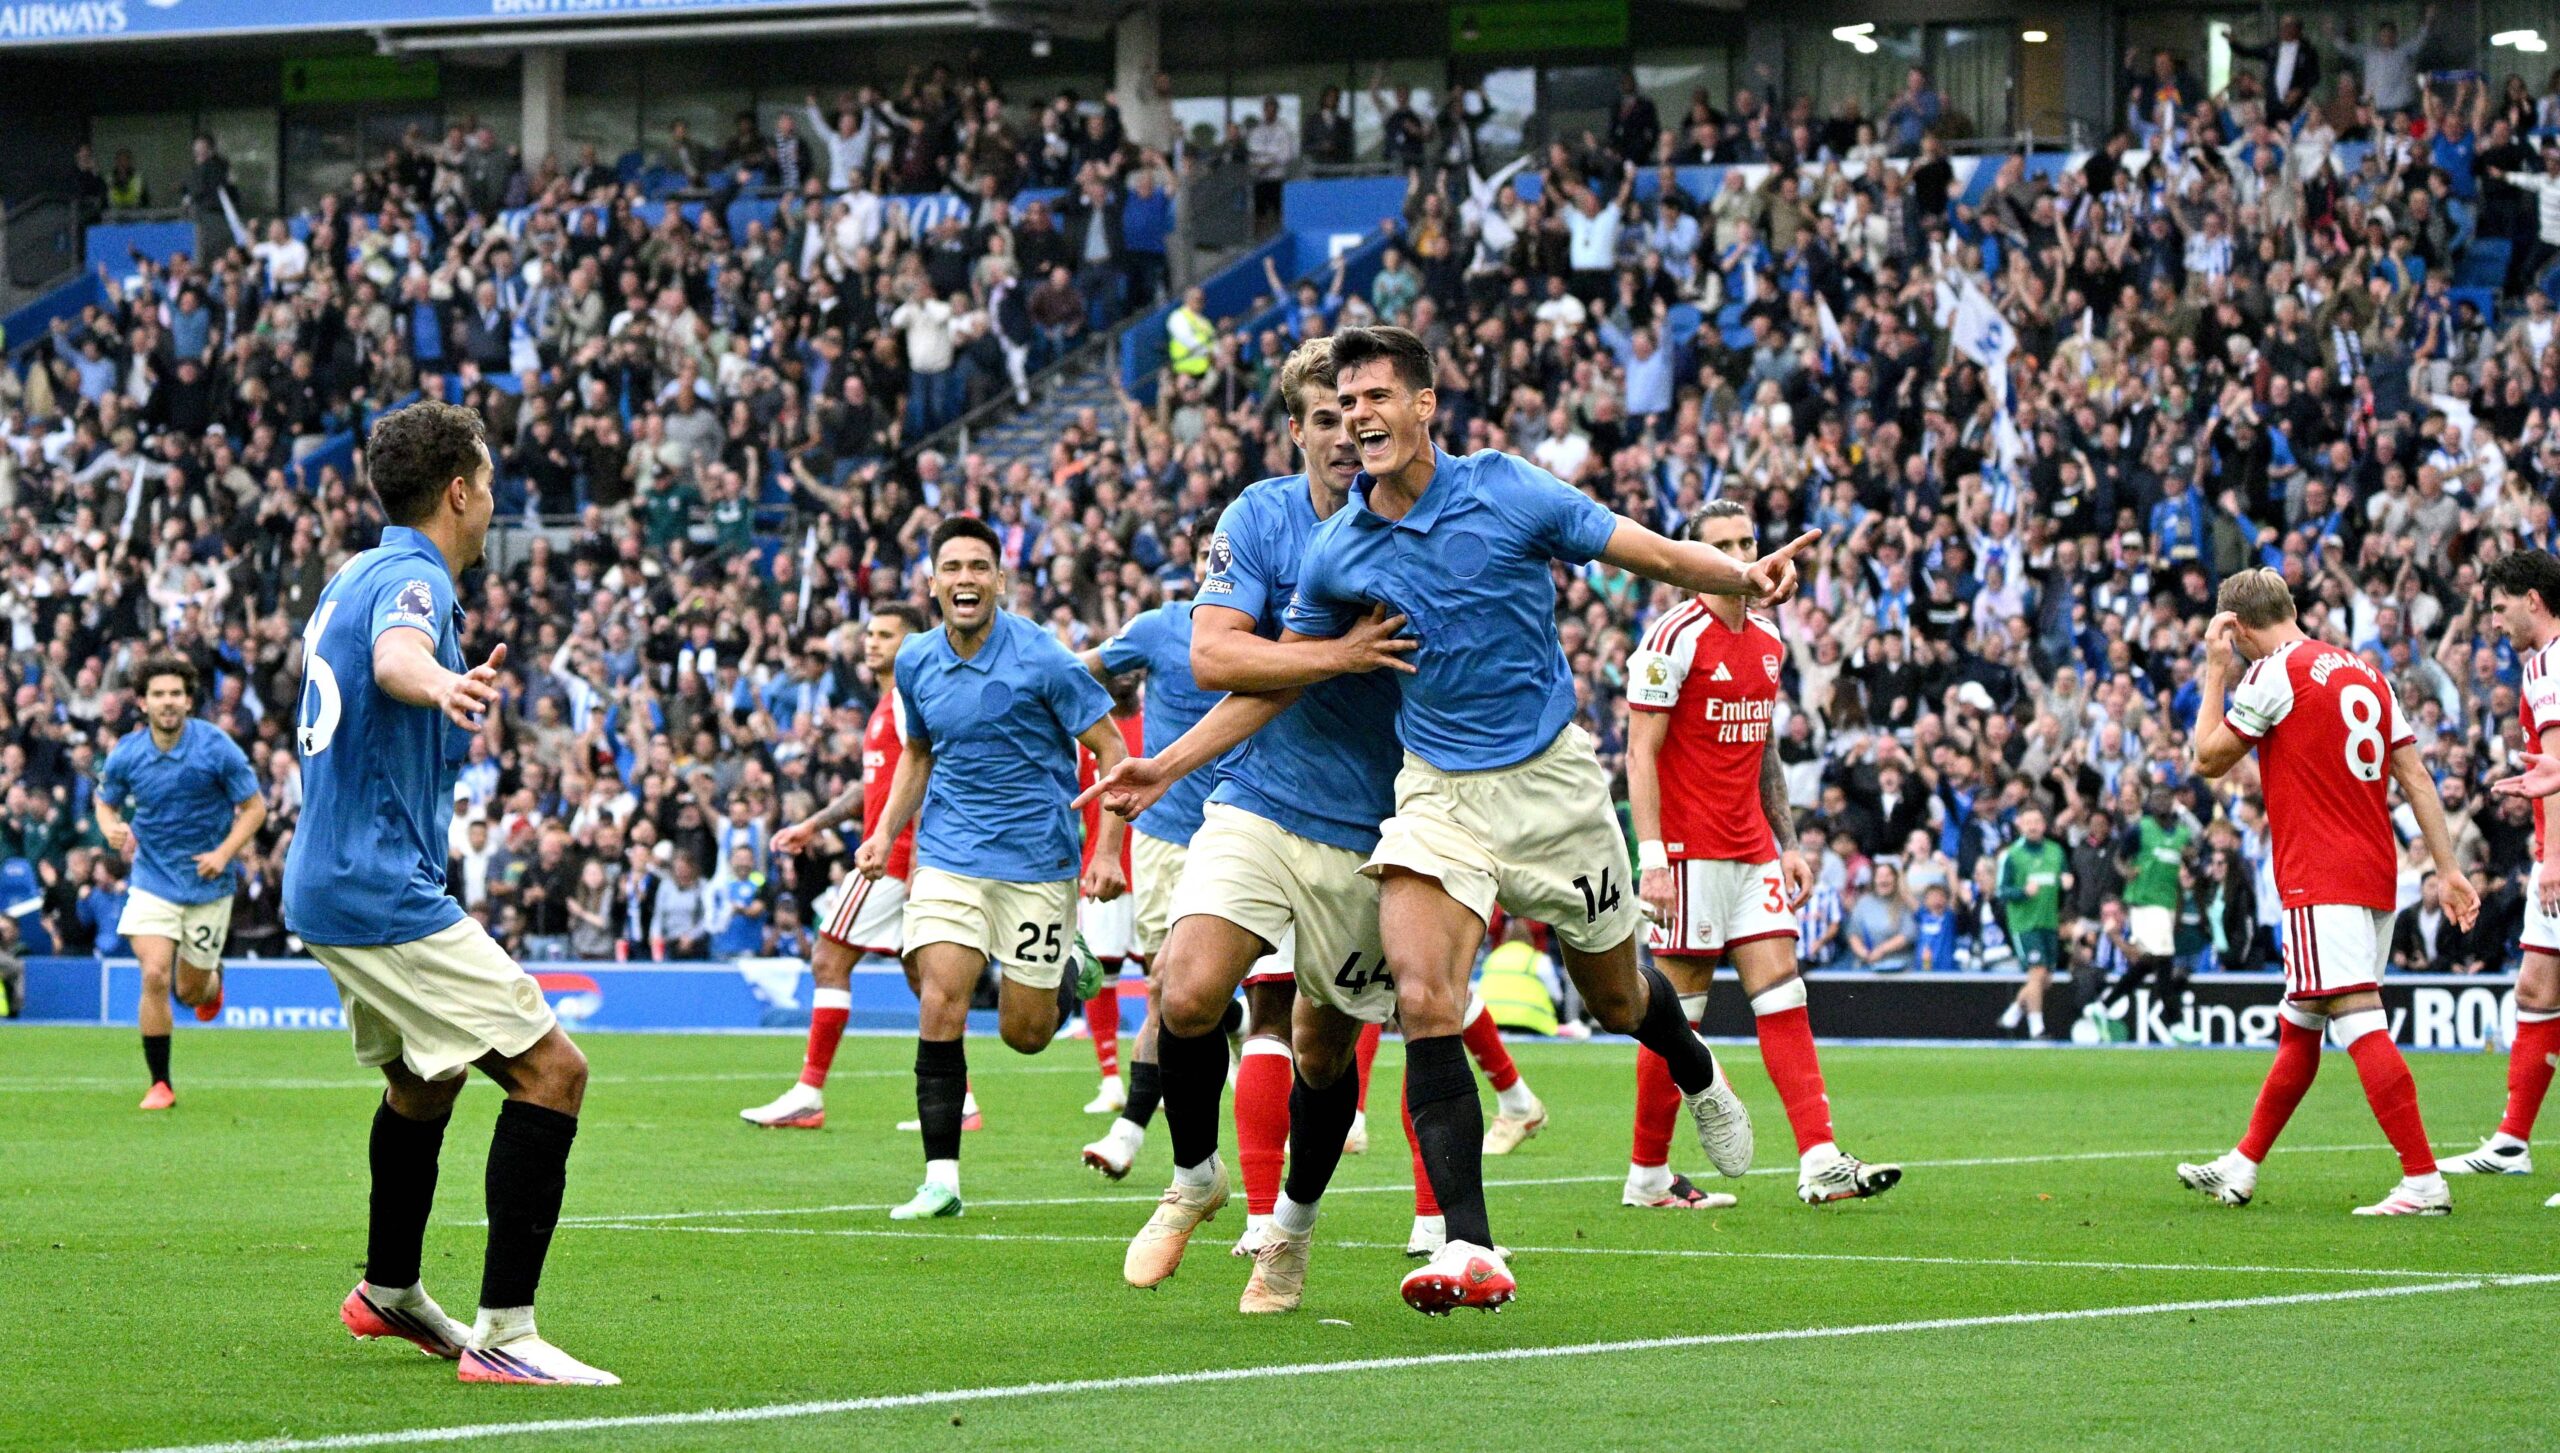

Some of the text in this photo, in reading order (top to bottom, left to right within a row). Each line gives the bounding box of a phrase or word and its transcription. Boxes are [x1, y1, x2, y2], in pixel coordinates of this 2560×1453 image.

[0, 2, 128, 37] AIRWAYS
[1718, 723, 1739, 743] FLY
[2340, 683, 2385, 782] 8
[1572, 866, 1621, 924] 14
[1015, 921, 1062, 964] 25
[1334, 951, 1395, 995] 44
